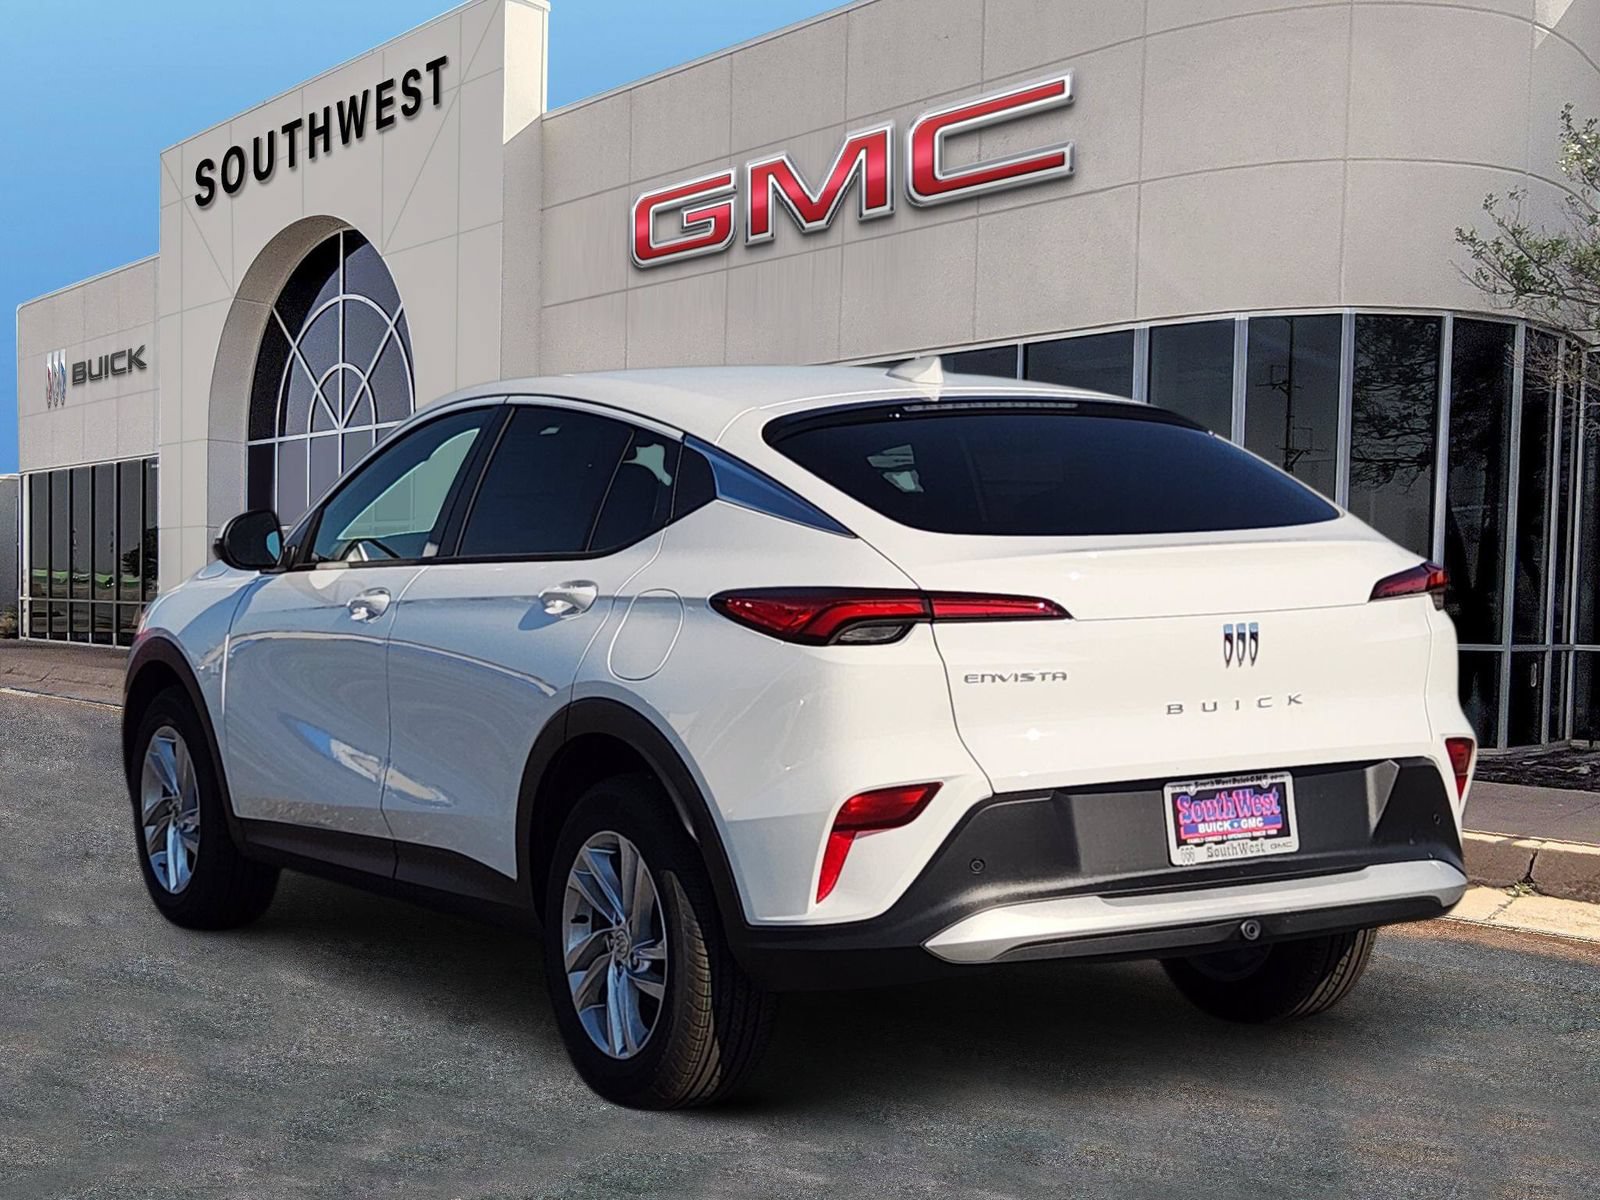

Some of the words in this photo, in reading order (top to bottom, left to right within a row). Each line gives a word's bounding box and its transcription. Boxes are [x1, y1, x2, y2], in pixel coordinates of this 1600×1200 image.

[194, 55, 448, 208] SOUTHWEST
[630, 69, 1075, 268] GMC
[72, 344, 147, 386] BUICK
[963, 671, 1068, 684] ENVISTA
[1166, 693, 1304, 716] BUICK
[1177, 787, 1280, 824] SouthWest
[1197, 820, 1232, 834] BUICK
[1240, 816, 1265, 829] GMC
[1206, 842, 1266, 858] SouthWest
[1270, 841, 1293, 850] GMC
